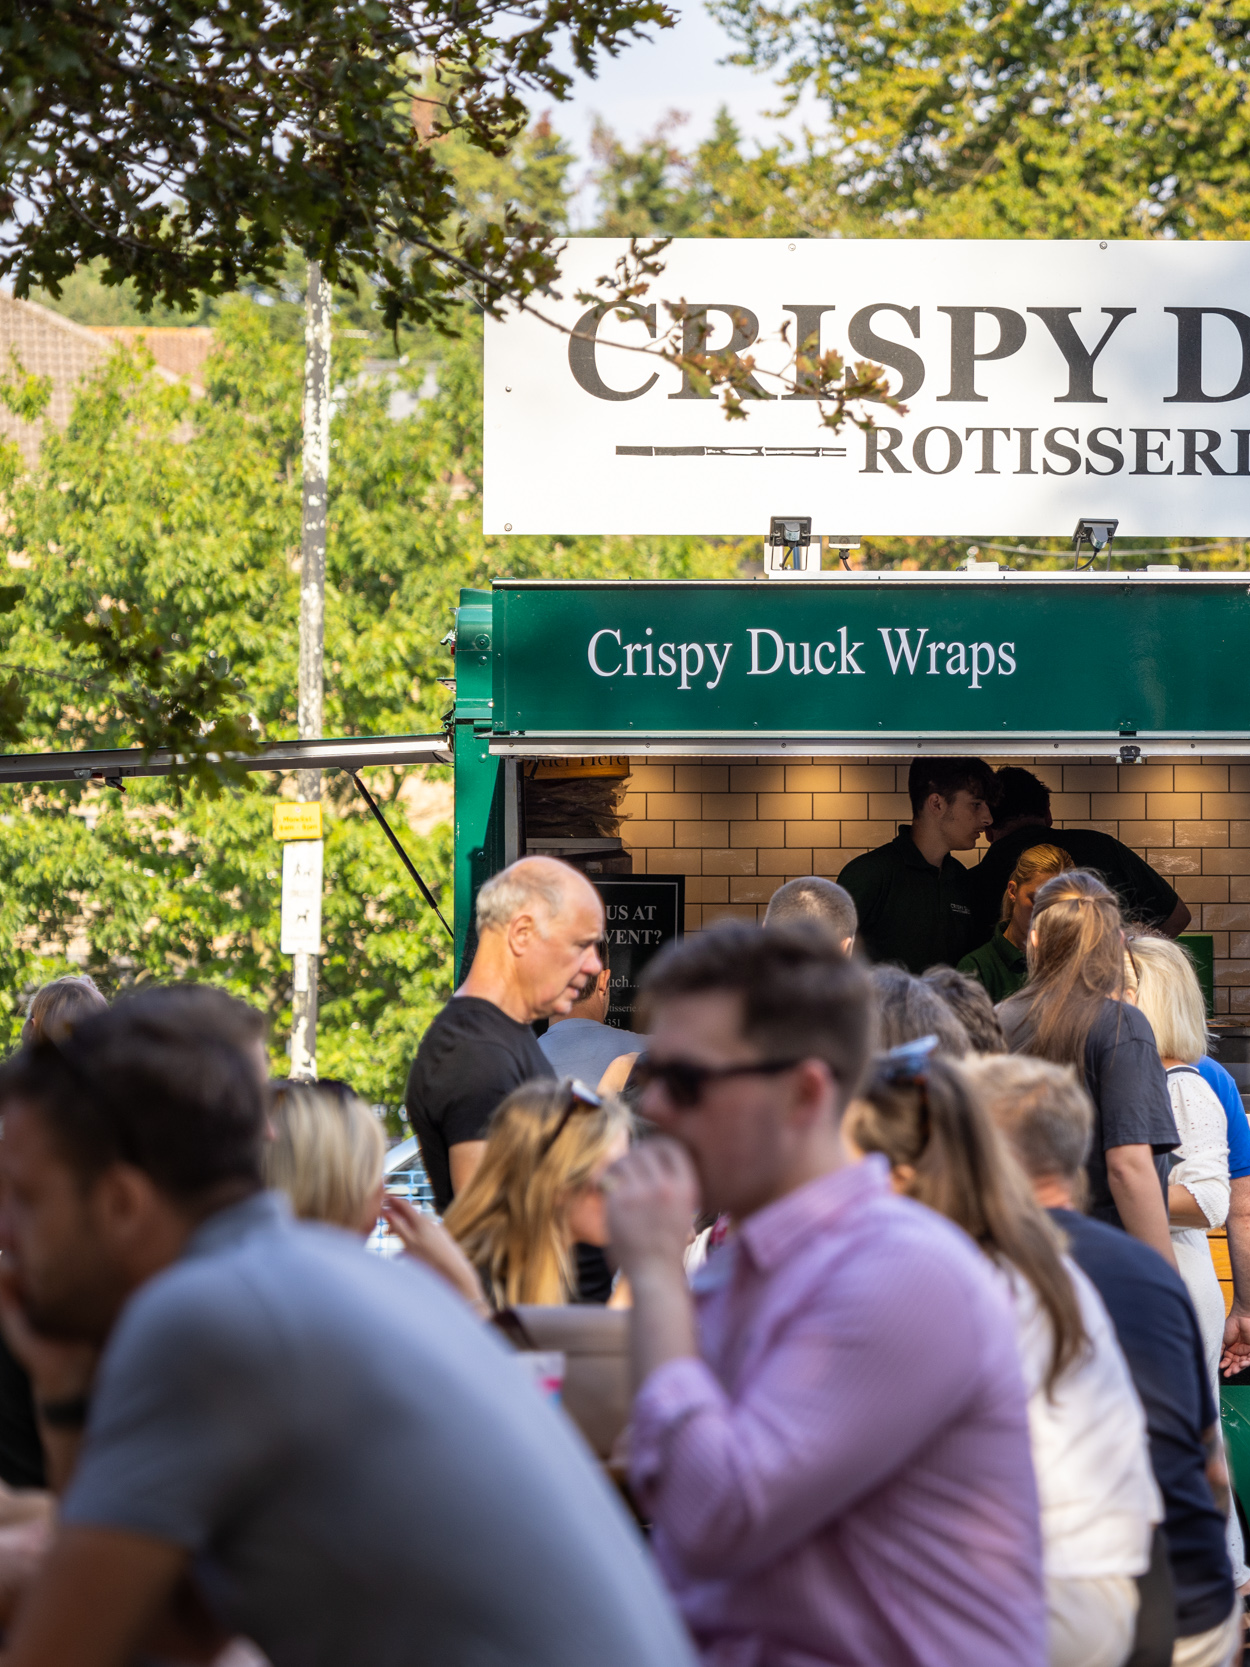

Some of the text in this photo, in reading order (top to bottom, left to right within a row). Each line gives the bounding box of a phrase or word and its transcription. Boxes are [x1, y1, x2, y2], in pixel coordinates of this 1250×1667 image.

[568, 300, 1136, 403] CRISPY
[587, 626, 1016, 690] Crispy Duck Wraps
[605, 905, 657, 920] US AT
